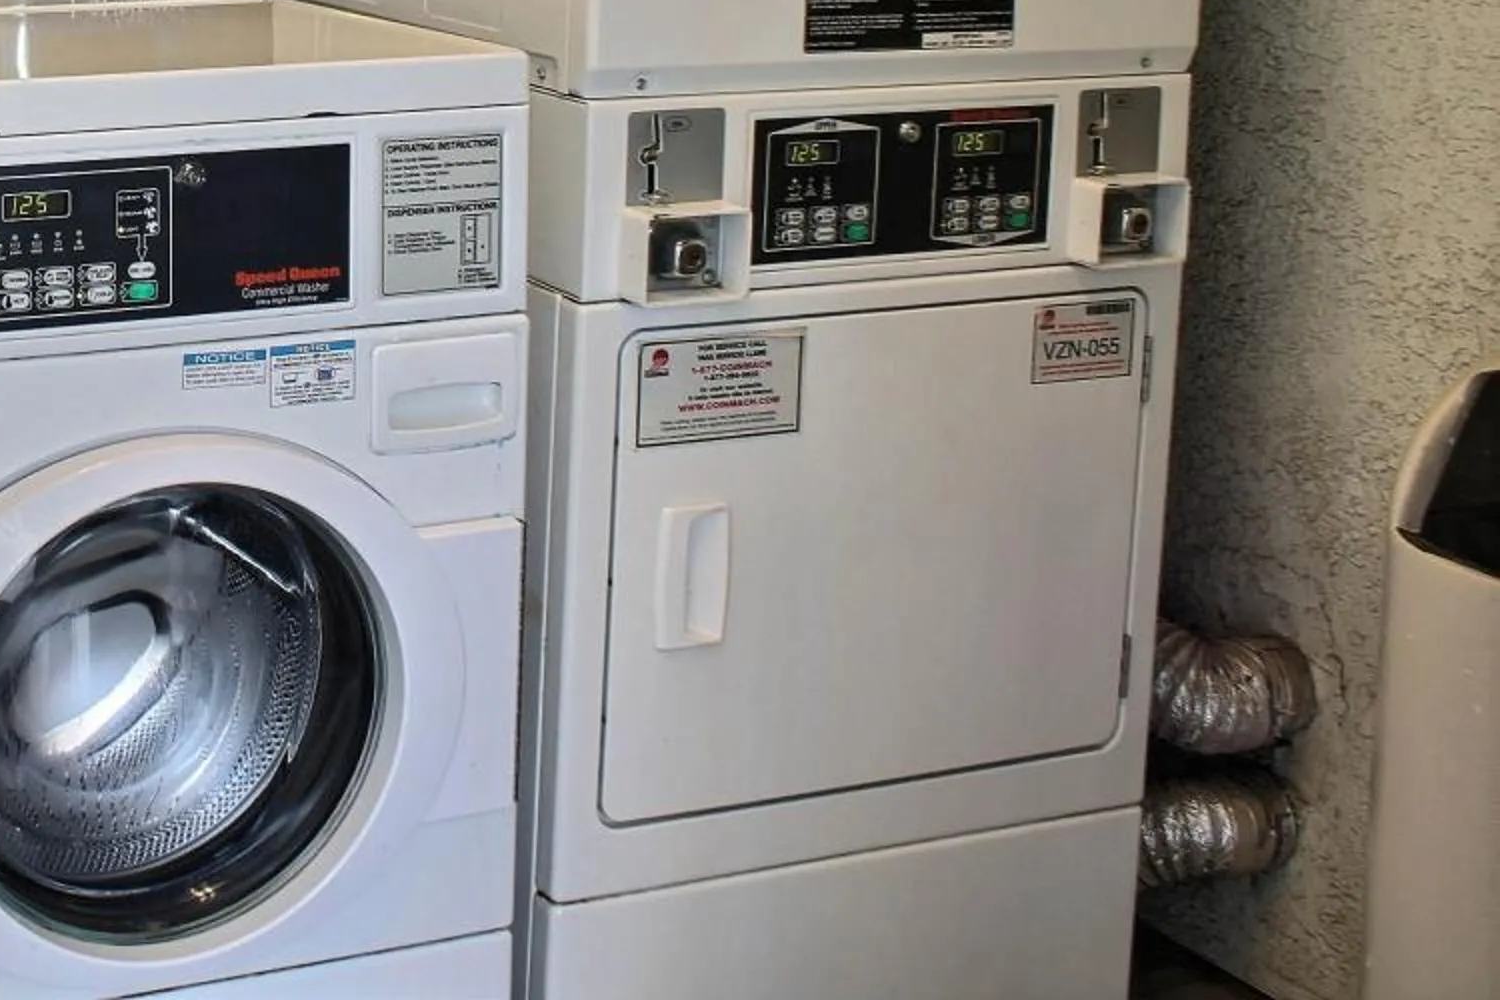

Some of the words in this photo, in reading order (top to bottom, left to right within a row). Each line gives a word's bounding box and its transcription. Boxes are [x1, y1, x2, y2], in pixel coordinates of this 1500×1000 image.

[957, 132, 985, 151] 125
[790, 143, 820, 162] 125
[11, 195, 48, 216] 125
[236, 268, 287, 286] Speed
[289, 266, 340, 280] Queen
[195, 351, 257, 363] NOTICE
[1043, 337, 1121, 360] VZN-055
